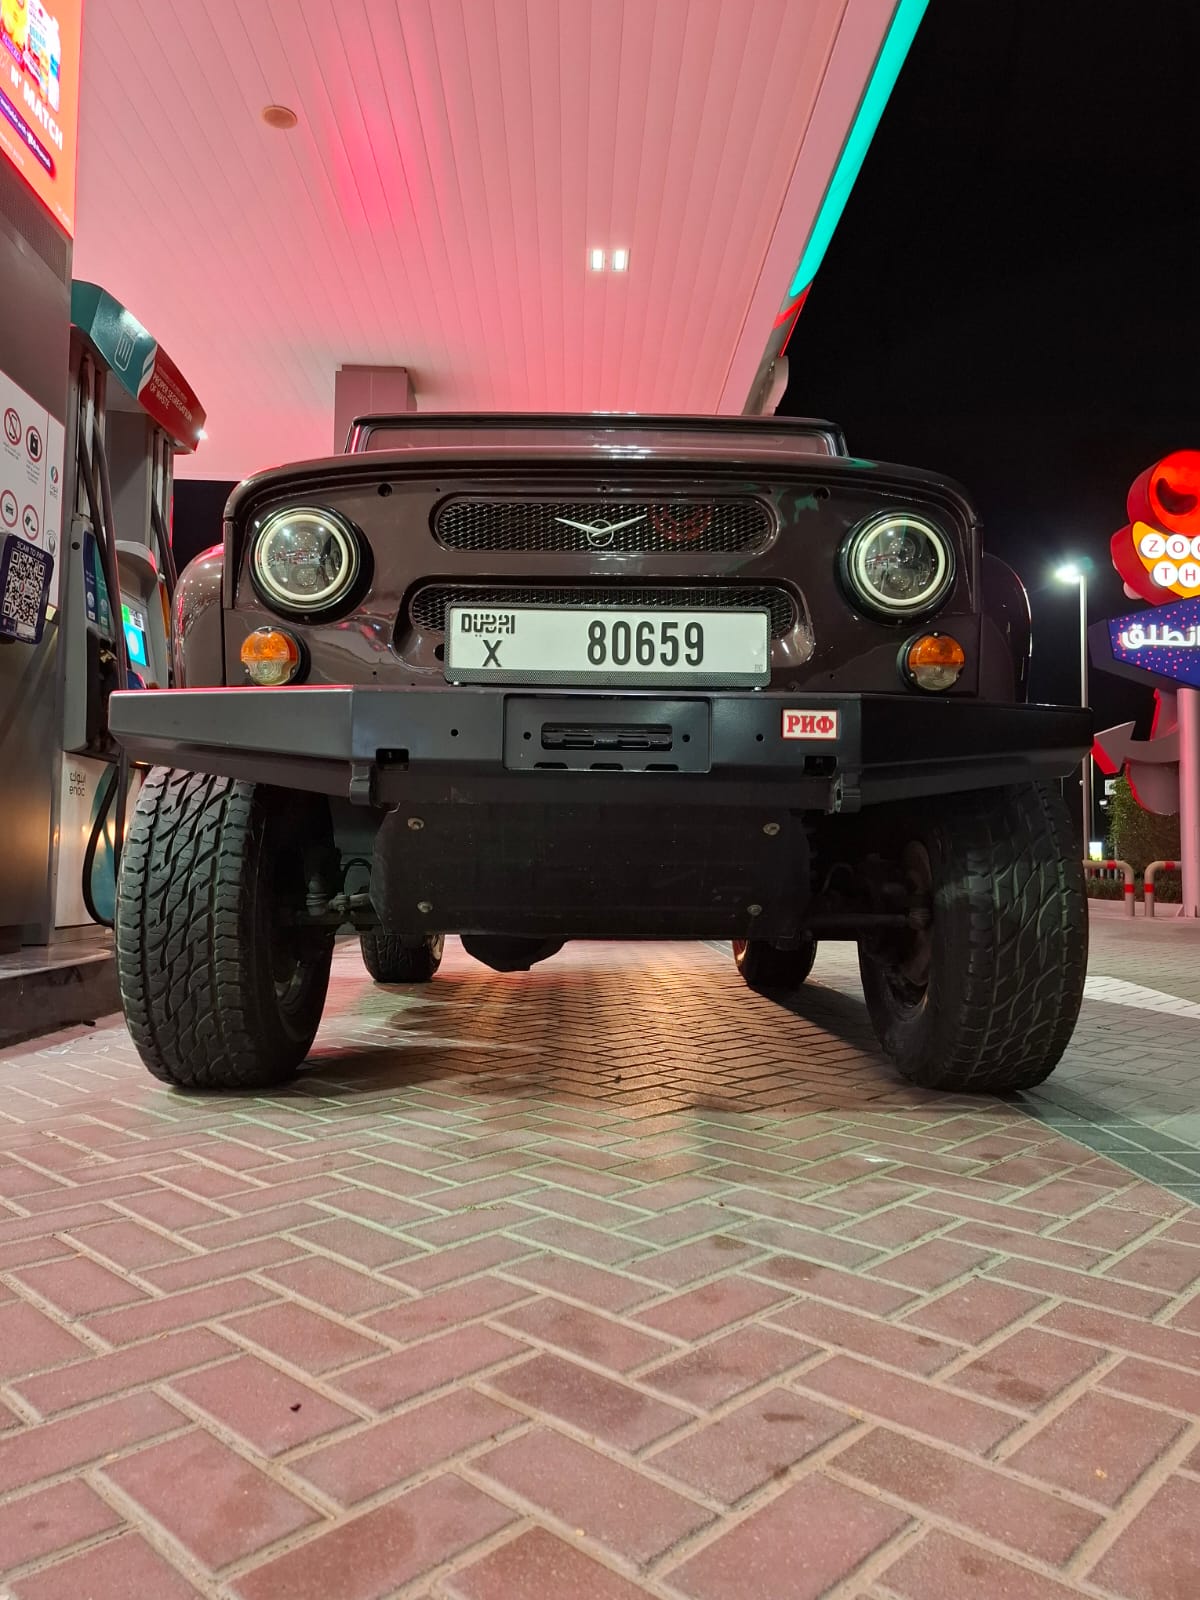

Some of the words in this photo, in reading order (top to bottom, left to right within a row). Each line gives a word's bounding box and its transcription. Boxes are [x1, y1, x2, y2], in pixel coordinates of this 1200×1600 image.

[23, 80, 63, 151] MATCH
[150, 382, 157, 393] OF
[156, 390, 170, 409] WASTE
[167, 389, 193, 422] SEGREGATION
[16, 541, 30, 553] SCAN
[29, 547, 37, 557] TO
[461, 613, 515, 635] DUBAI
[482, 639, 502, 667] X
[587, 620, 704, 666] 80659
[786, 714, 834, 733] РИФ
[69, 785, 85, 797] enoc
